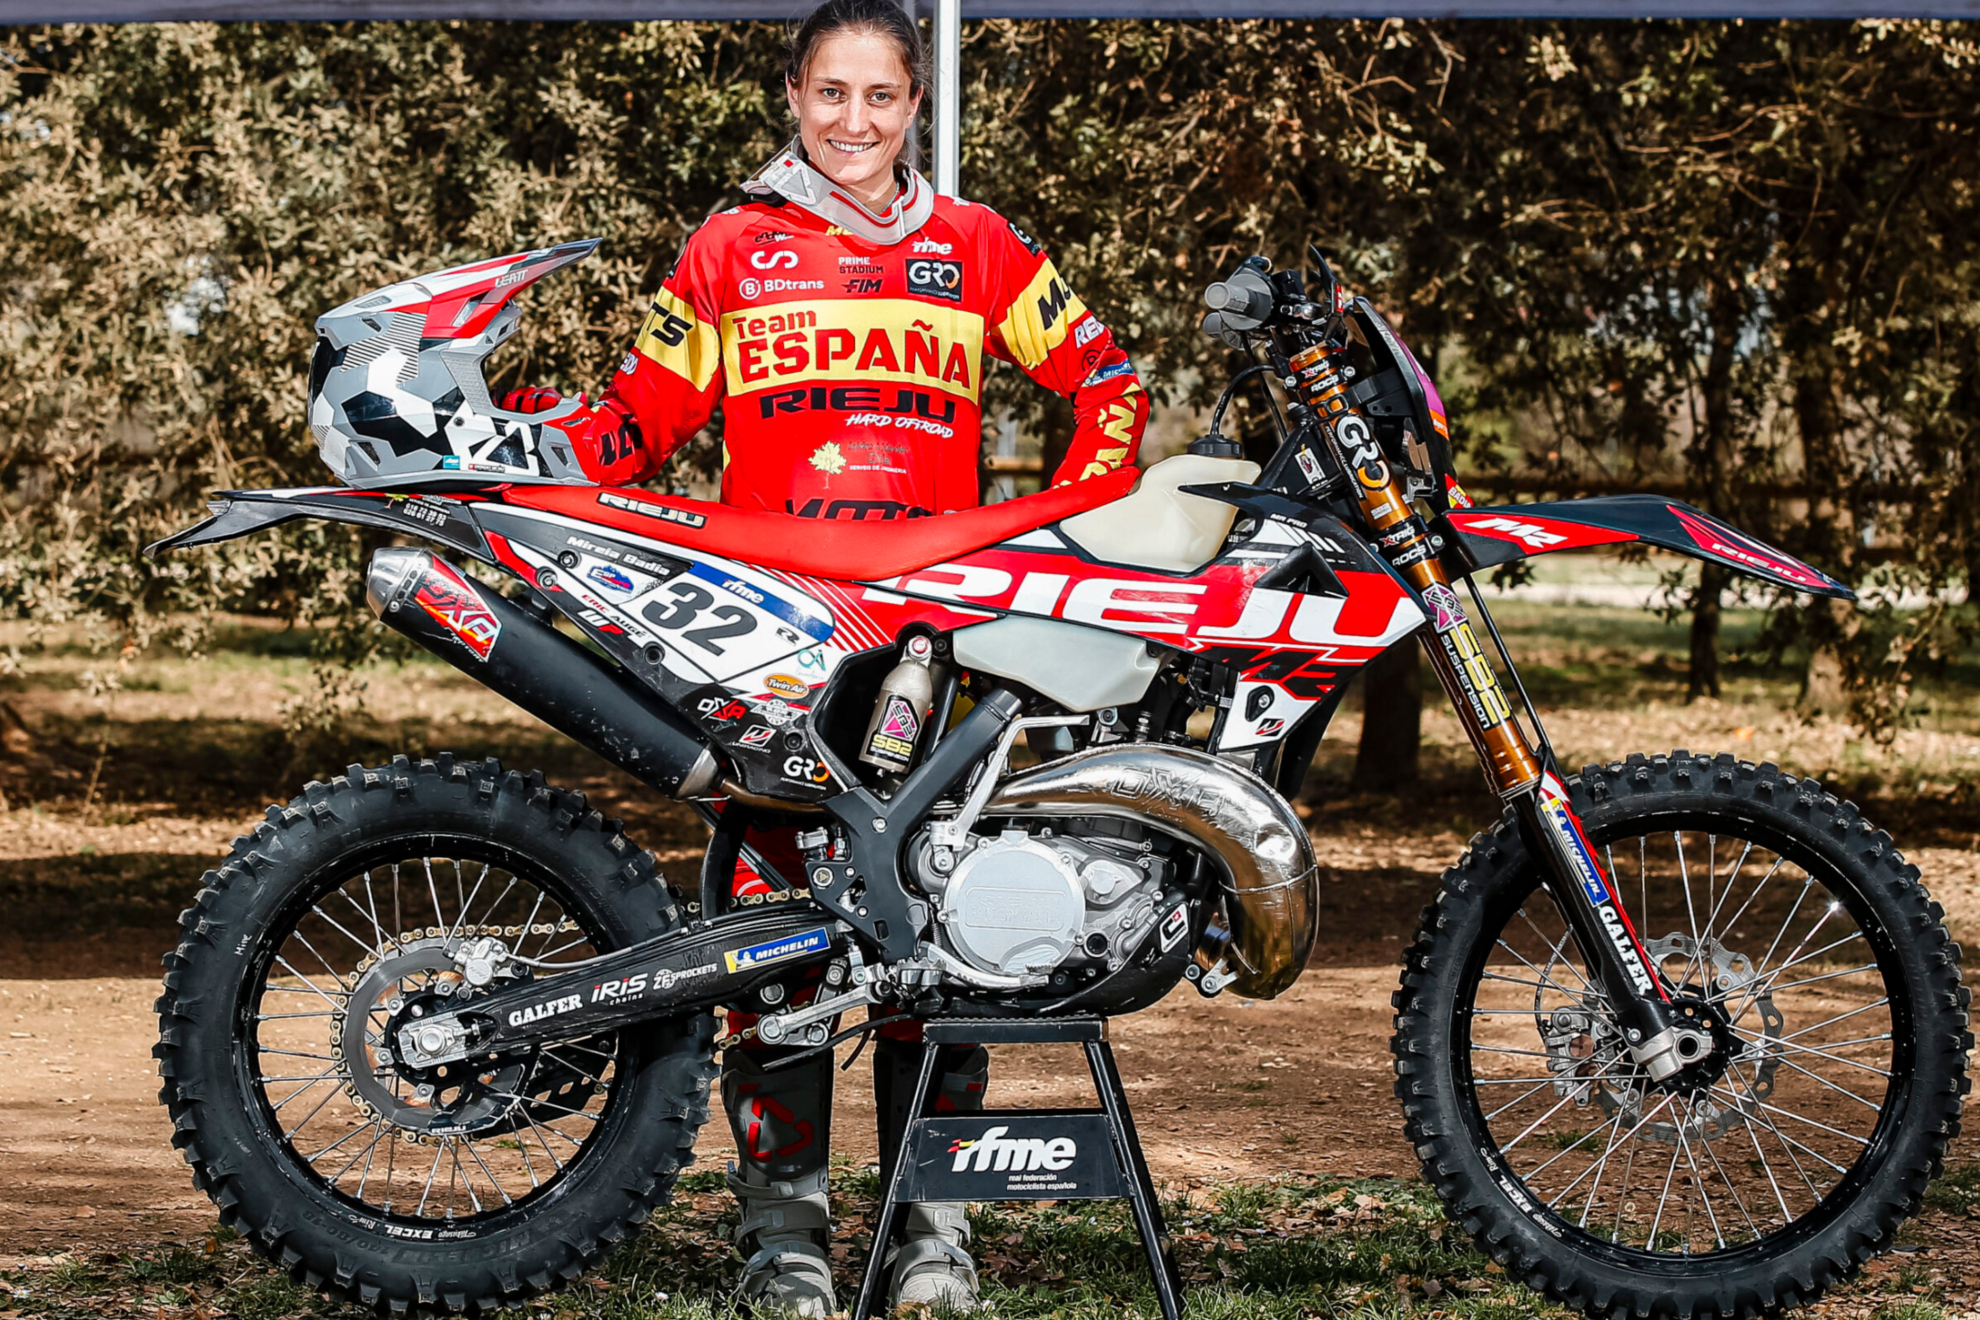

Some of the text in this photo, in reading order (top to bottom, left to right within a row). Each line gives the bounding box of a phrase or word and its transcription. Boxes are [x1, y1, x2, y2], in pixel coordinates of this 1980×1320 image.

[838, 256, 870, 265] PRIME
[839, 265, 884, 275] STADIUM
[495, 269, 529, 288] LEATT
[764, 278, 825, 292] BDtrans
[848, 279, 883, 294] FIM
[908, 261, 960, 289] GRO
[733, 310, 817, 340] Team
[737, 319, 971, 390] ESPAÑA
[1301, 360, 1330, 379] XTRIG
[1311, 374, 1339, 392] ROCS
[759, 387, 956, 425] RIEJU
[845, 413, 954, 439] HARD OFFROAD
[1337, 415, 1391, 488] GRO
[600, 493, 704, 526] RIEJU
[1287, 517, 1308, 528] PRO
[1379, 525, 1415, 548] XTRIG
[567, 536, 670, 576] Mireia Badia
[1392, 544, 1426, 566] ROCS
[1712, 543, 1806, 582] RIEJU
[581, 594, 610, 613] ERIC
[721, 578, 764, 604] rfme
[899, 562, 1427, 646] RIEJU
[642, 582, 757, 656] 32
[767, 678, 808, 695] Twin Air
[1441, 634, 1491, 729] SUSPENSION
[871, 734, 912, 757] SB2
[783, 756, 830, 782] GRO
[1563, 828, 1600, 897] MICHELIN
[755, 936, 819, 961] MICHELIN
[1599, 904, 1653, 995] GALFER
[670, 963, 718, 981] SPROCKETS
[508, 994, 583, 1028] GALFER
[610, 993, 643, 1006] chains
[950, 1126, 1077, 1173] rfme
[1008, 1173, 1058, 1182] real federación
[1046, 1182, 1077, 1191] española
[1499, 1175, 1533, 1213] EXCEL
[383, 1223, 435, 1240] EXCEL
